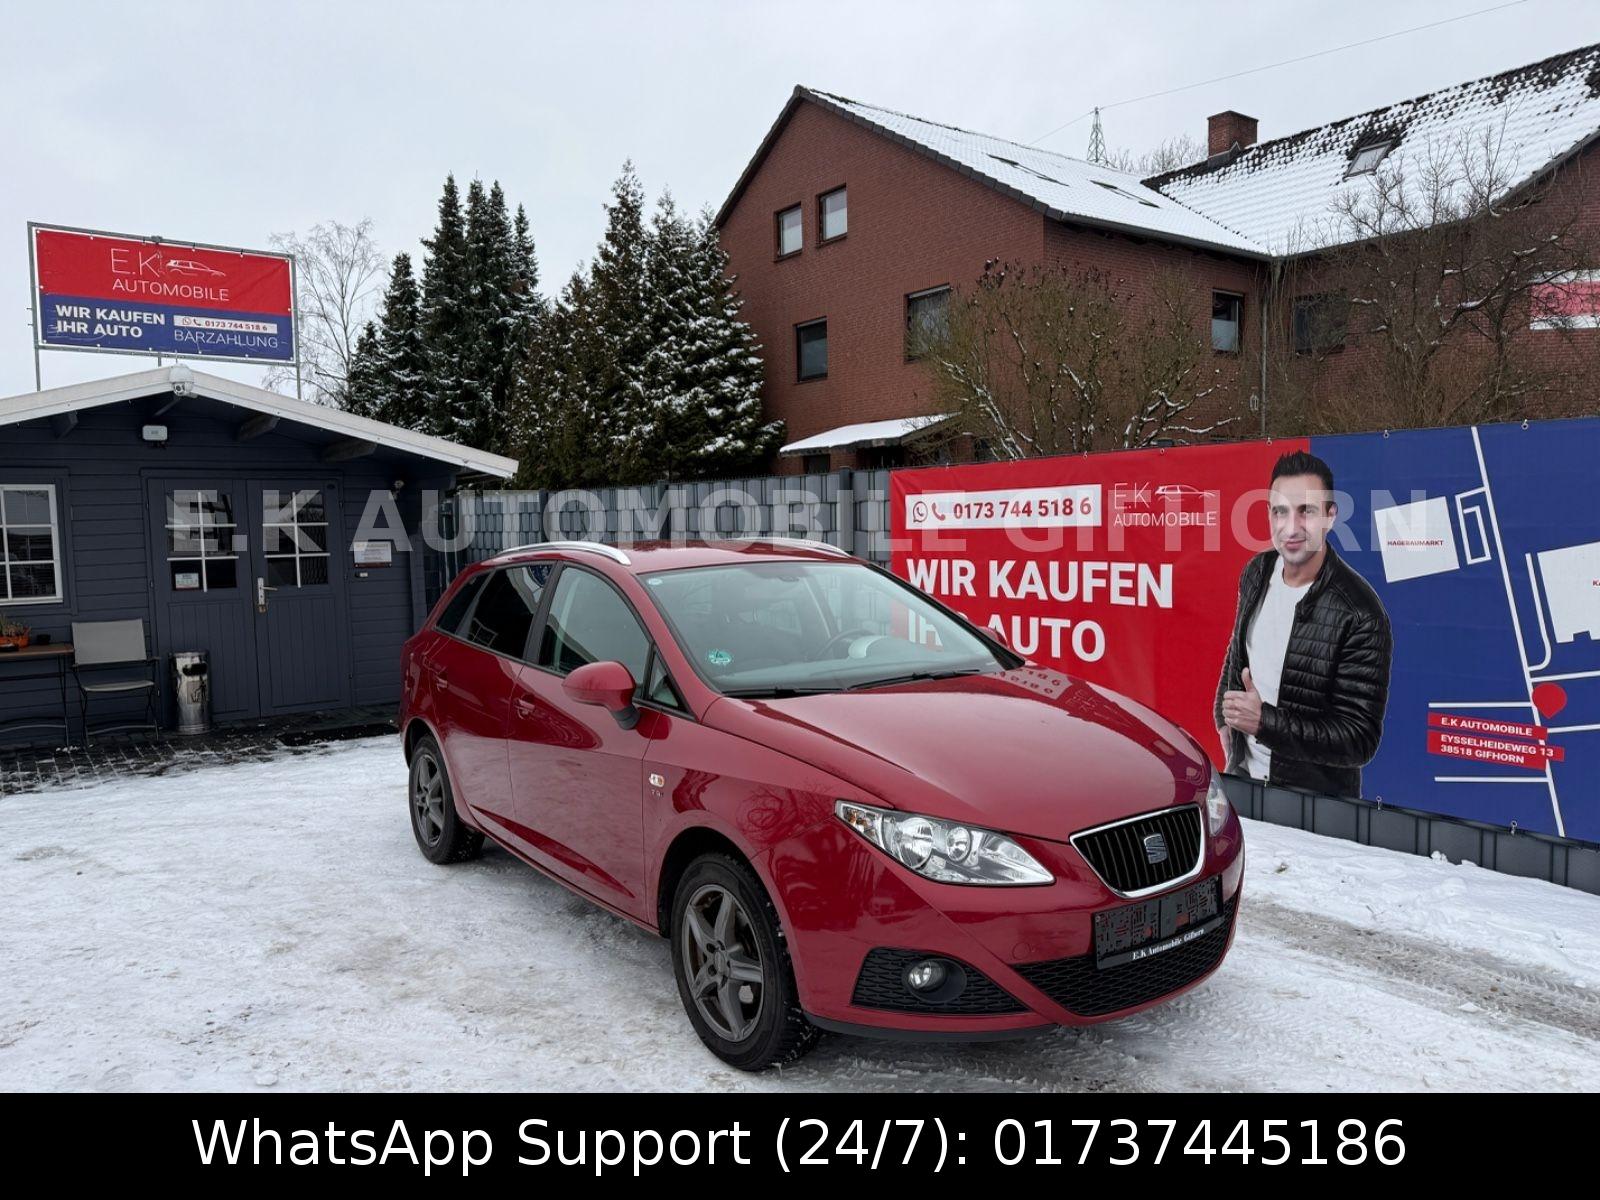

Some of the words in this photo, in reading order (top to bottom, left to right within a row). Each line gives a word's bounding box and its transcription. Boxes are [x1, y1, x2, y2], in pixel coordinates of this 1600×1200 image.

[111, 248, 160, 277] E.K
[112, 278, 230, 301] AUTOMOBILE
[55, 304, 91, 319] WIR
[95, 307, 165, 325] KAUFEN
[204, 320, 226, 328] 0173
[55, 321, 88, 333] IHR
[93, 323, 143, 338] AUTO
[174, 329, 278, 348] BARZAHLUNG
[1113, 482, 1151, 509] E.K
[953, 501, 995, 519] 0173
[999, 500, 1033, 517] 744
[1038, 497, 1073, 516] 518
[1080, 497, 1092, 515] 6
[1113, 511, 1218, 527] AUTOMOBILE
[906, 558, 977, 597] WIR
[988, 560, 1174, 608] KAUFEN
[1441, 717, 1458, 727] E.K
[1460, 720, 1533, 737] AUTOMOBILE
[1440, 734, 1537, 755] EYSSELHEIDEWEG
[1540, 748, 1554, 757] 13
[1440, 744, 1472, 756] 38518
[1475, 749, 1525, 764] GIFHORN
